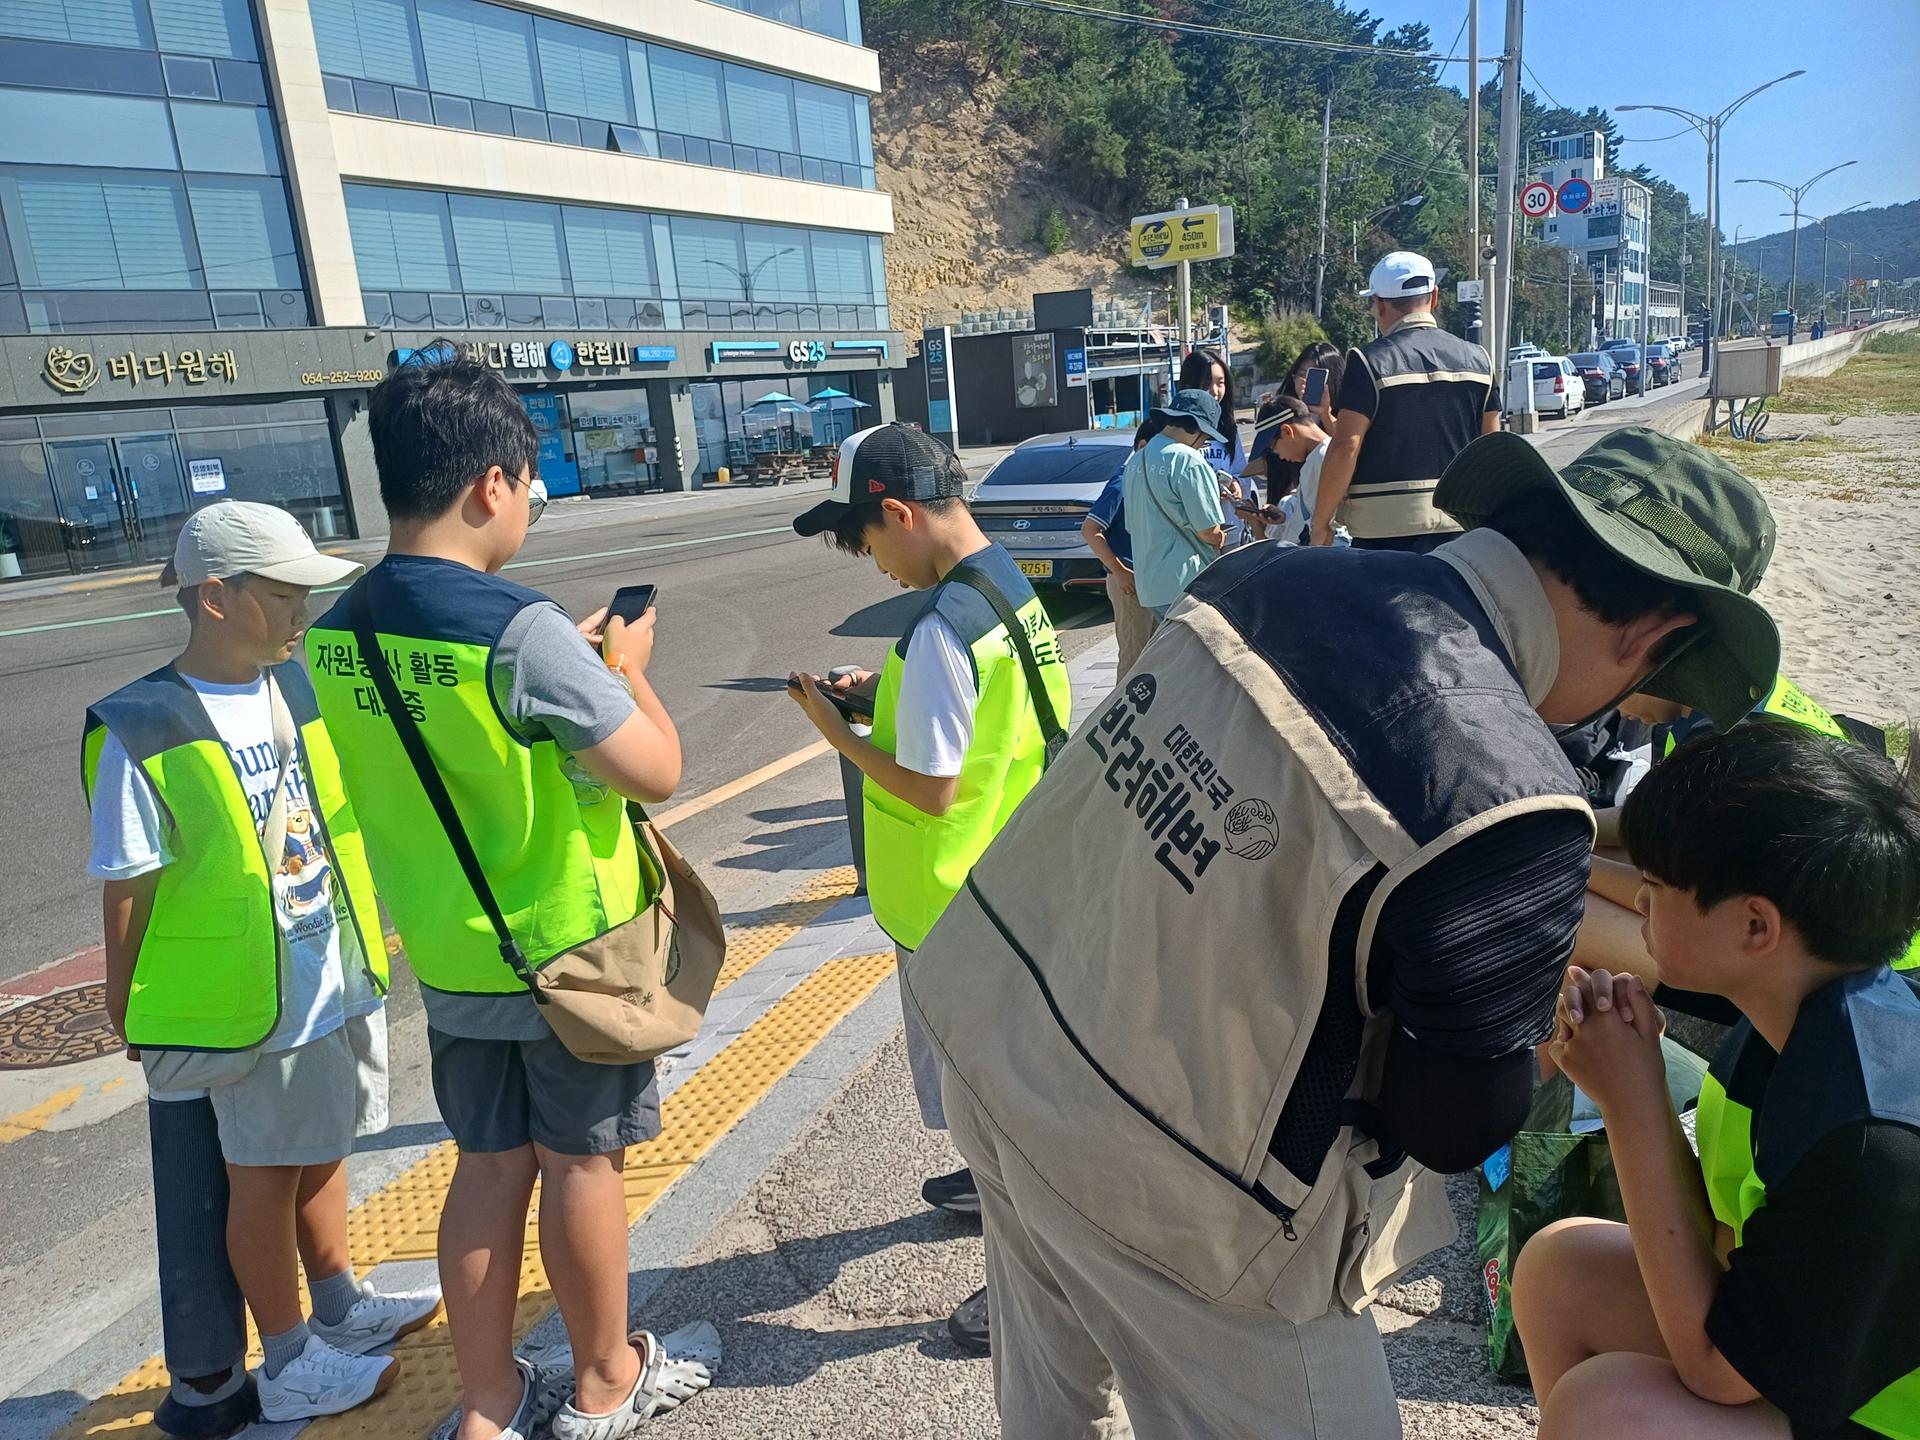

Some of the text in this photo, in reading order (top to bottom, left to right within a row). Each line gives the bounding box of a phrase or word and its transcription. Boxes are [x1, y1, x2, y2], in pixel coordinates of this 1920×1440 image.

[1527, 193, 1546, 208] 30
[1562, 191, 1587, 201] 주차금지
[1182, 231, 1204, 241] 450m
[789, 340, 827, 362] GS25
[928, 339, 943, 351] GS
[929, 351, 943, 363] 25
[108, 349, 239, 387] 바다원해
[302, 370, 383, 384] 054-252-9200
[1021, 563, 1047, 574] 8751
[409, 651, 459, 688] 활동
[354, 686, 427, 723] 대중
[1163, 723, 1235, 811] 대한민국
[1086, 697, 1222, 895] 반려해변
